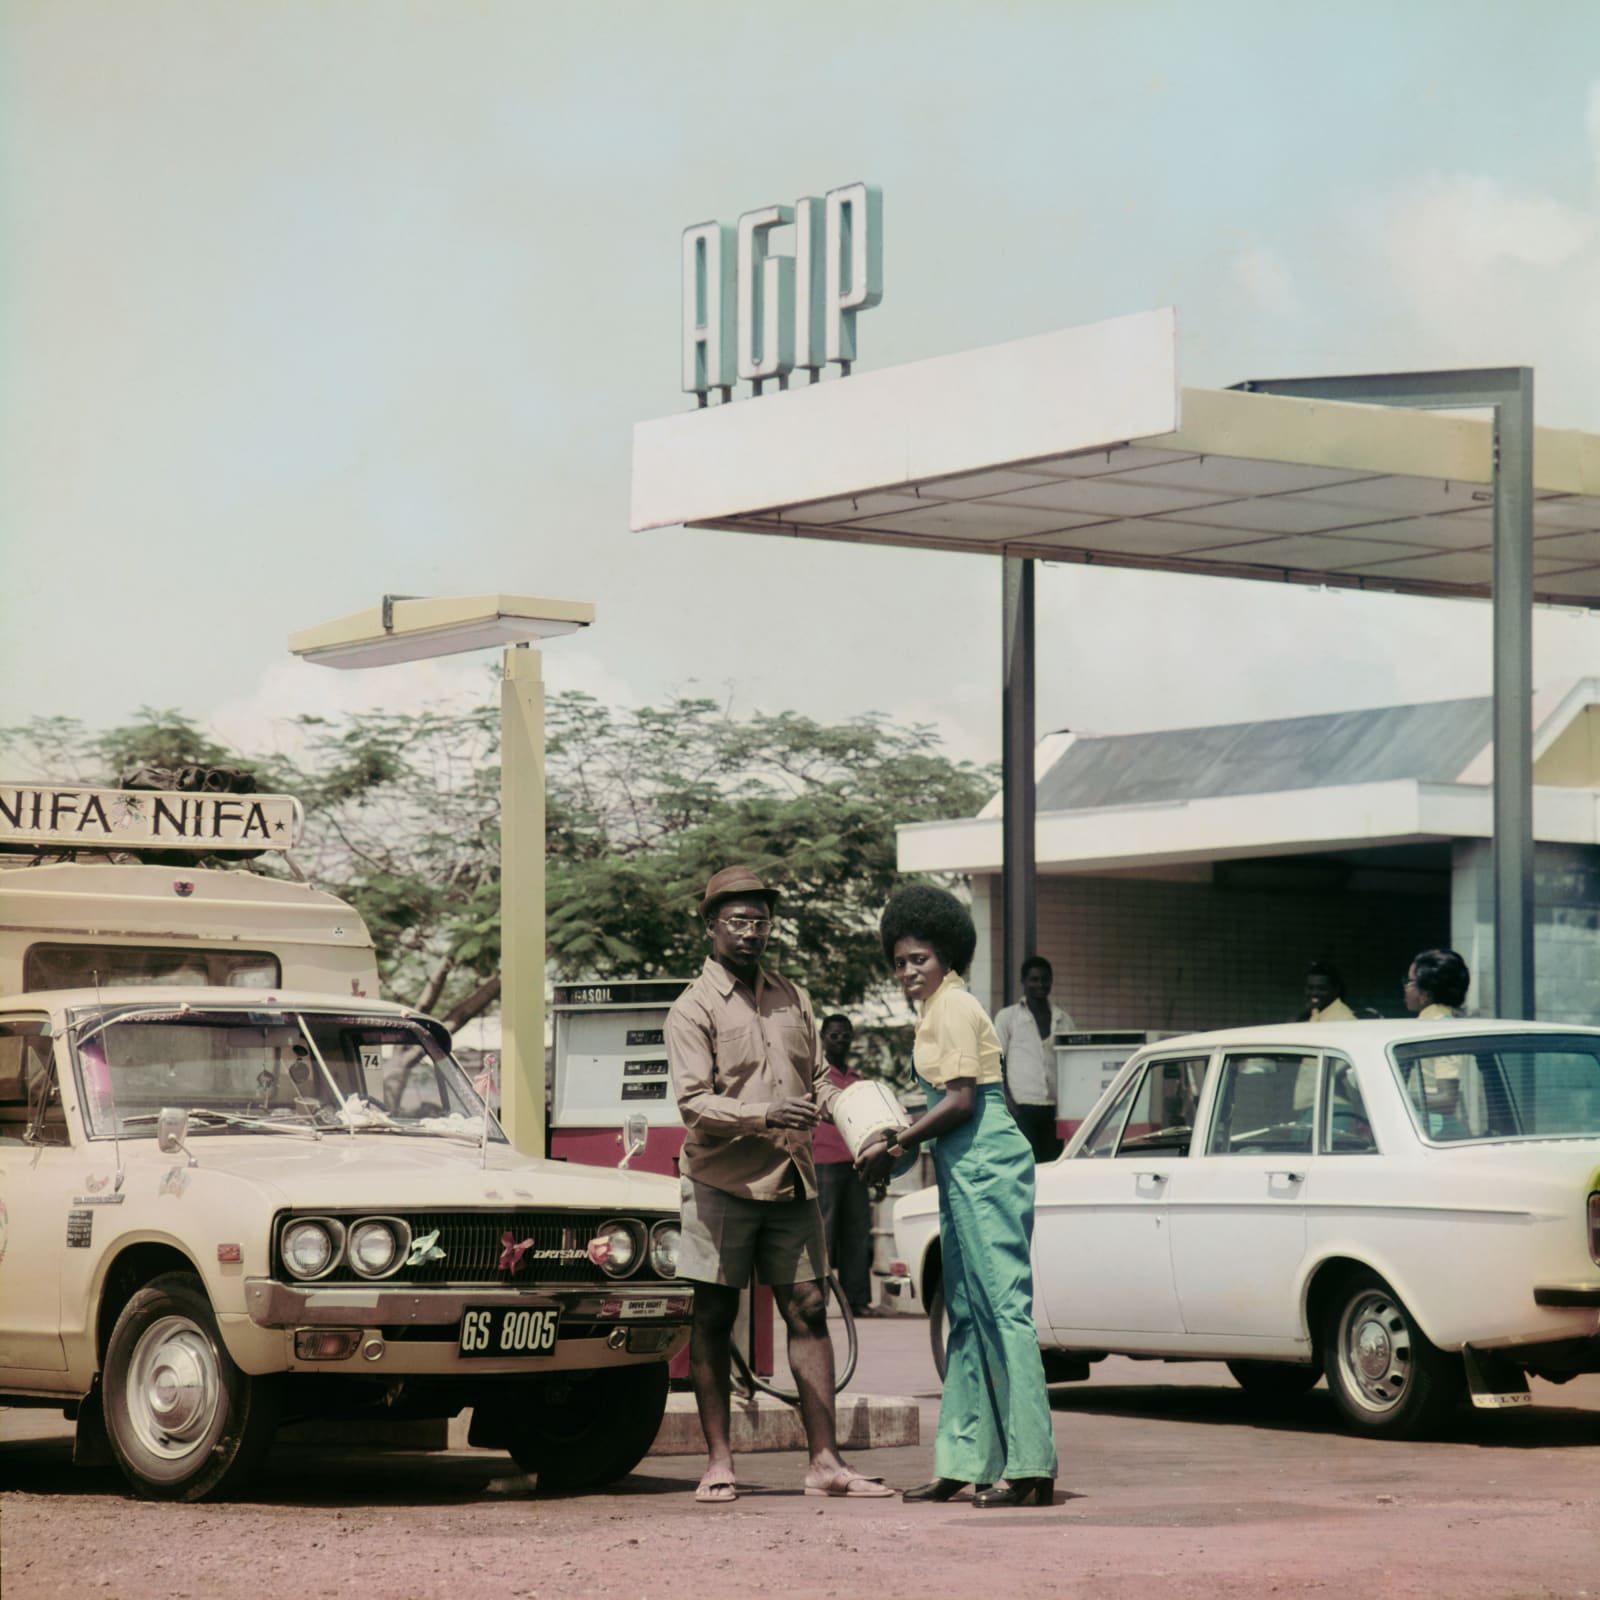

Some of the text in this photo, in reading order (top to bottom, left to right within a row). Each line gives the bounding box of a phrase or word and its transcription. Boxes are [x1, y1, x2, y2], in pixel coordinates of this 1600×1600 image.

[681, 182, 884, 393] AGIP
[152, 797, 271, 838] NIFA
[364, 1055, 378, 1067] 74
[533, 1249, 589, 1258] DATSUN
[462, 1311, 557, 1350] GS 8005
[1477, 1395, 1531, 1403] VOLVO
